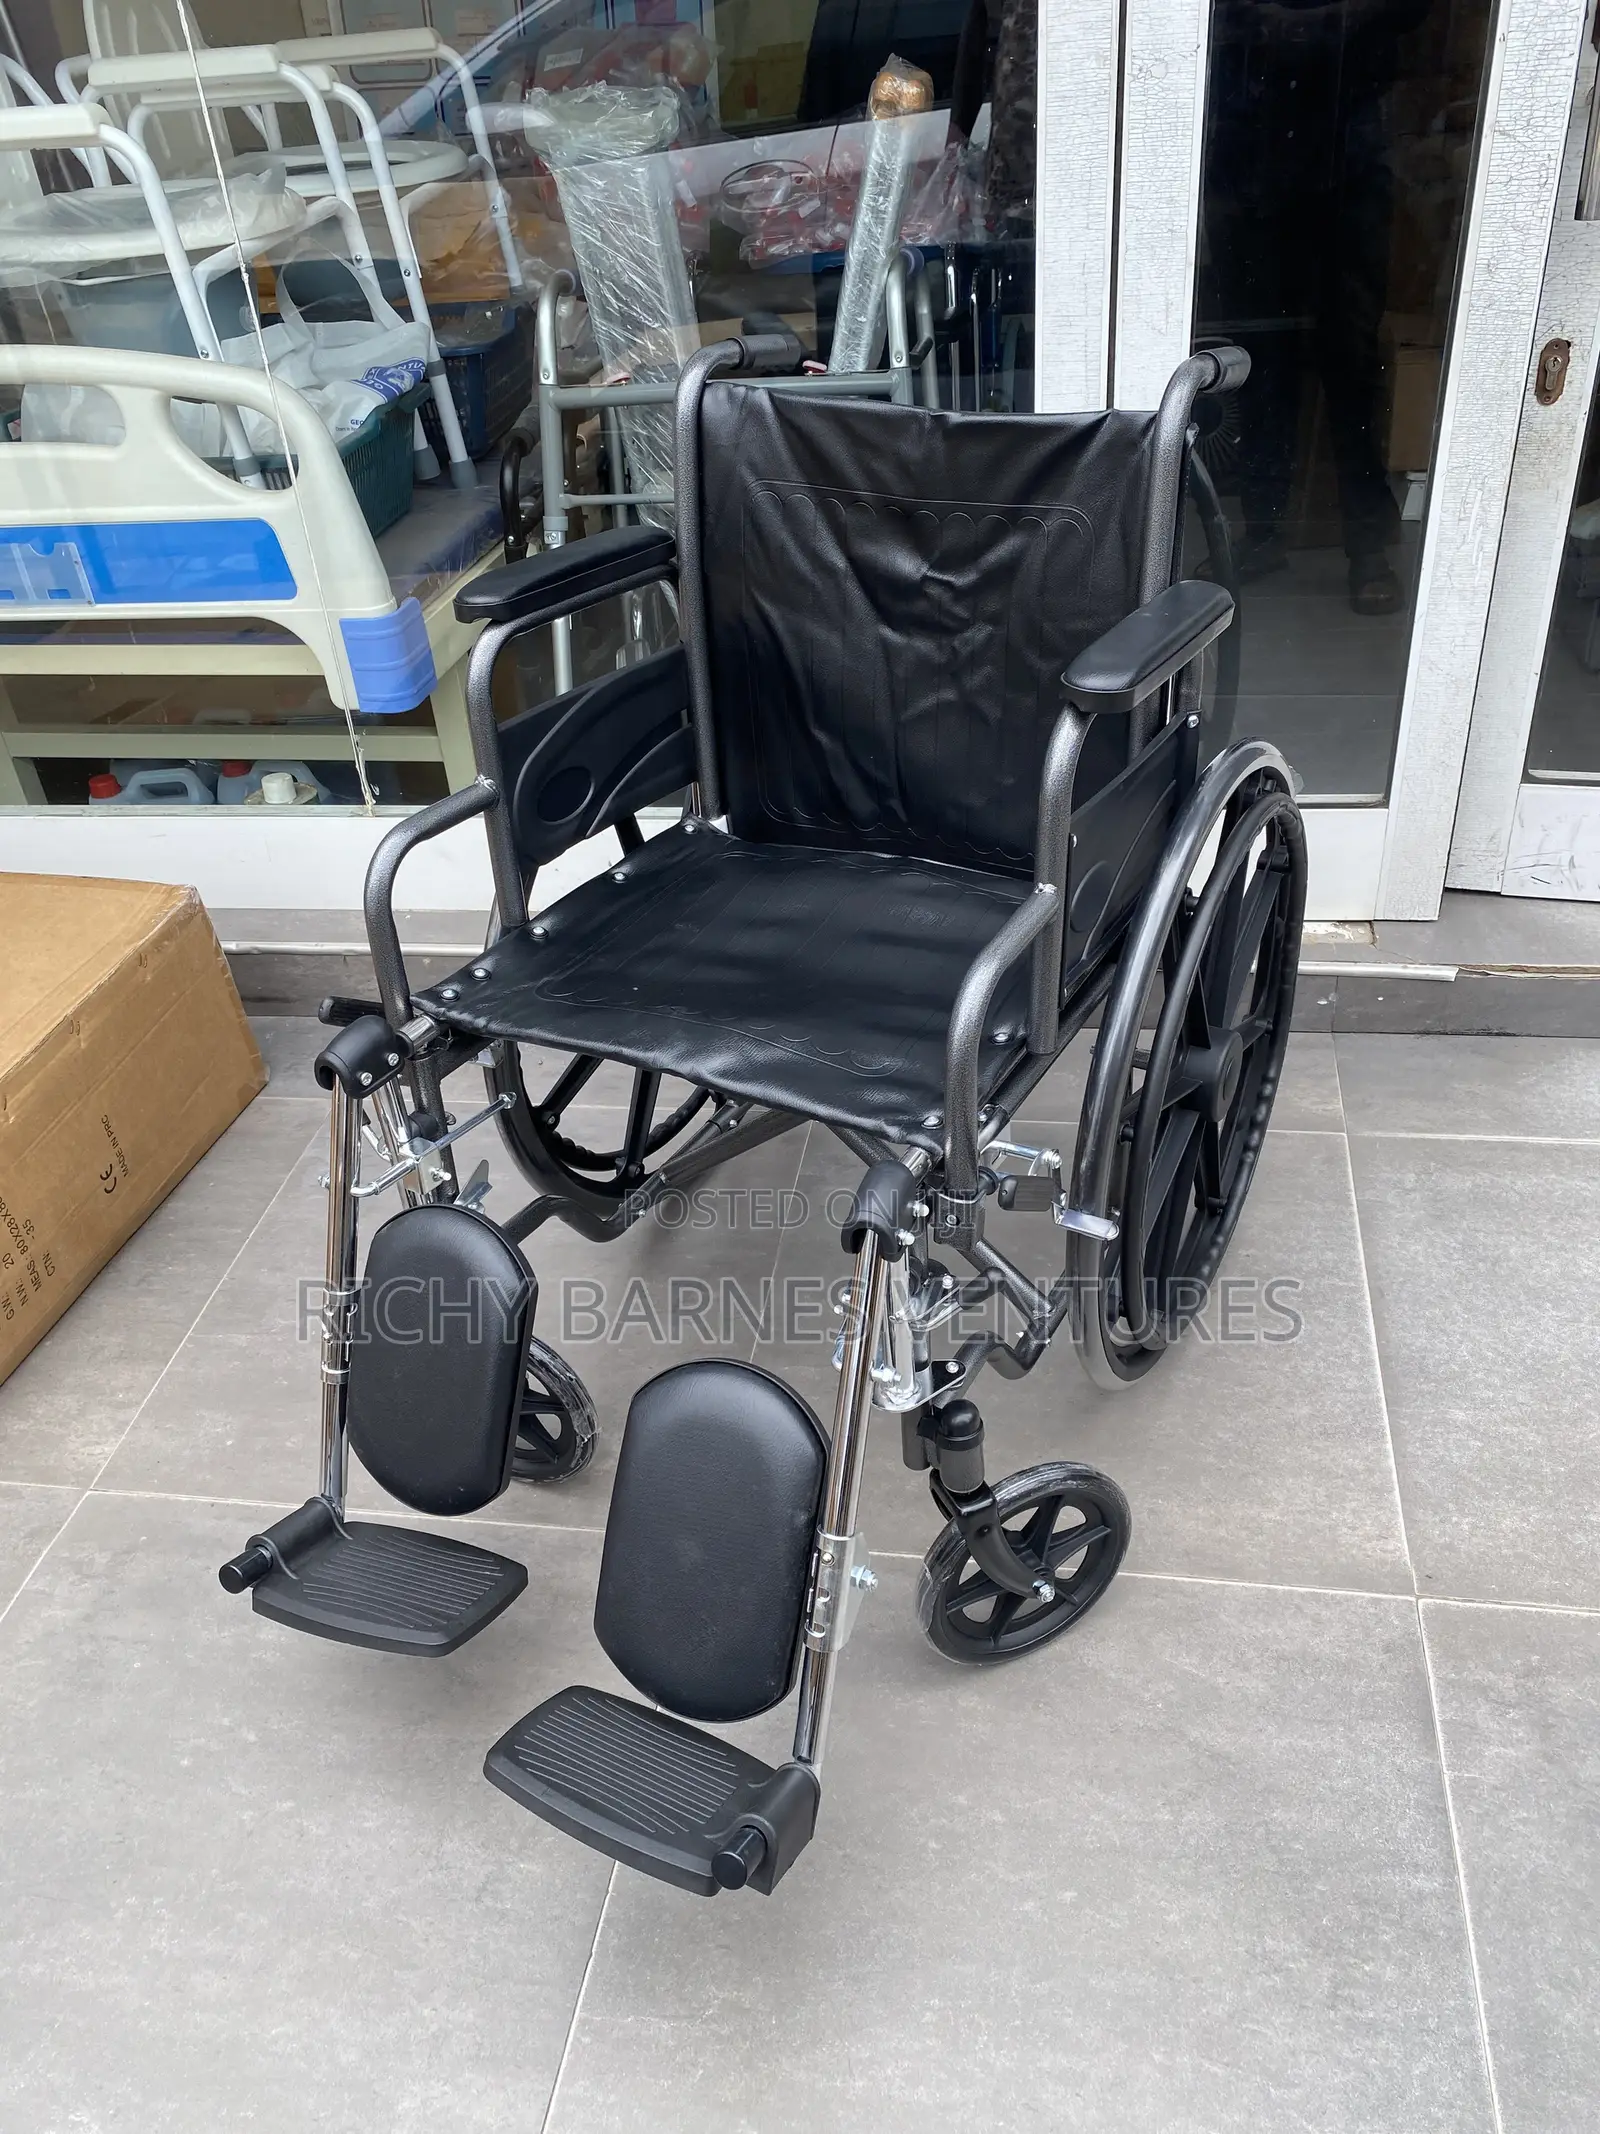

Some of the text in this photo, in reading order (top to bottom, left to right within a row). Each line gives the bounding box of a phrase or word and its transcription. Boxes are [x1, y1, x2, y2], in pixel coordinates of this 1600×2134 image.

[101, 1114, 129, 1178] MADE IN PRC
[0, 1196, 29, 1255] 80X28X8
[2, 1252, 15, 1270] 20
